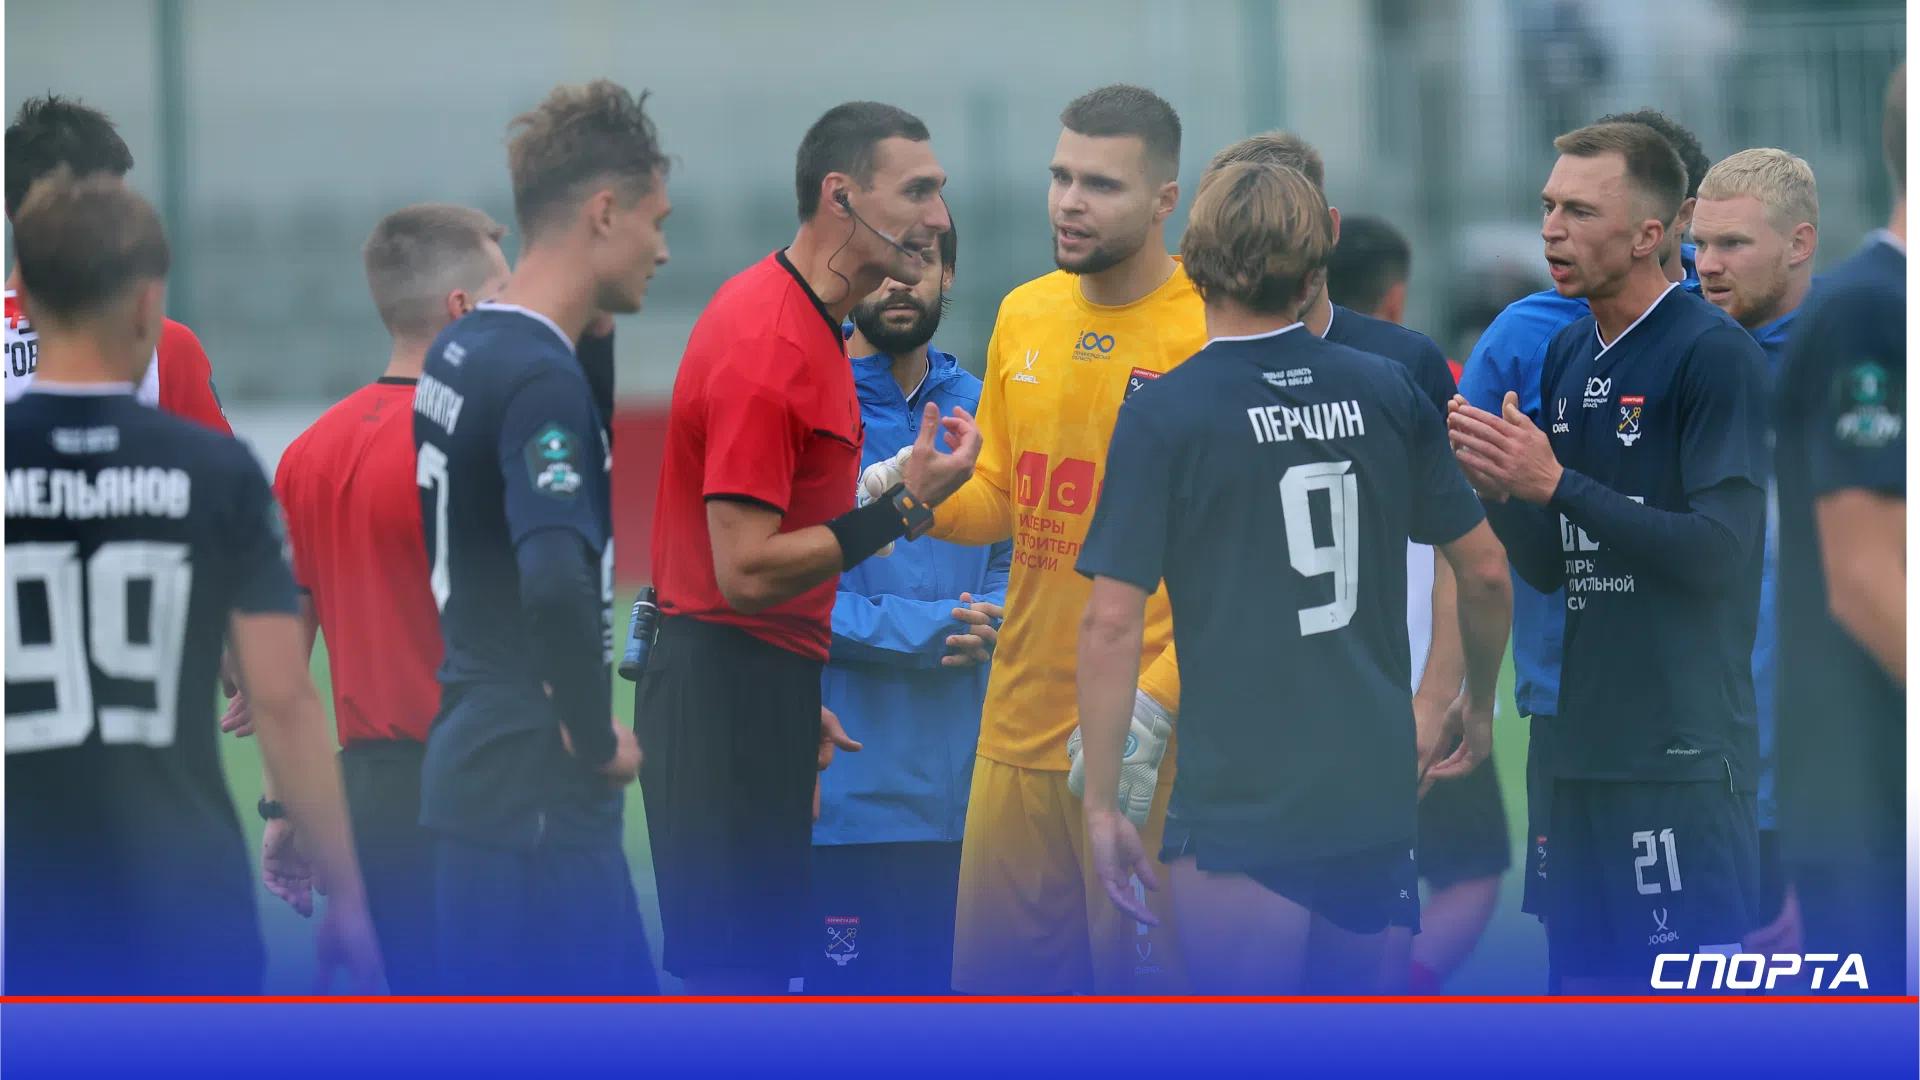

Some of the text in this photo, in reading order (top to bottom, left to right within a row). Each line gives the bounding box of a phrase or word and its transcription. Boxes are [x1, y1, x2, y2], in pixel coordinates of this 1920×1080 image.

[1247, 400, 1365, 444] ПЕРШИН
[1279, 461, 1358, 636] 9
[4, 540, 193, 754] 99
[1632, 828, 1682, 895] 21
